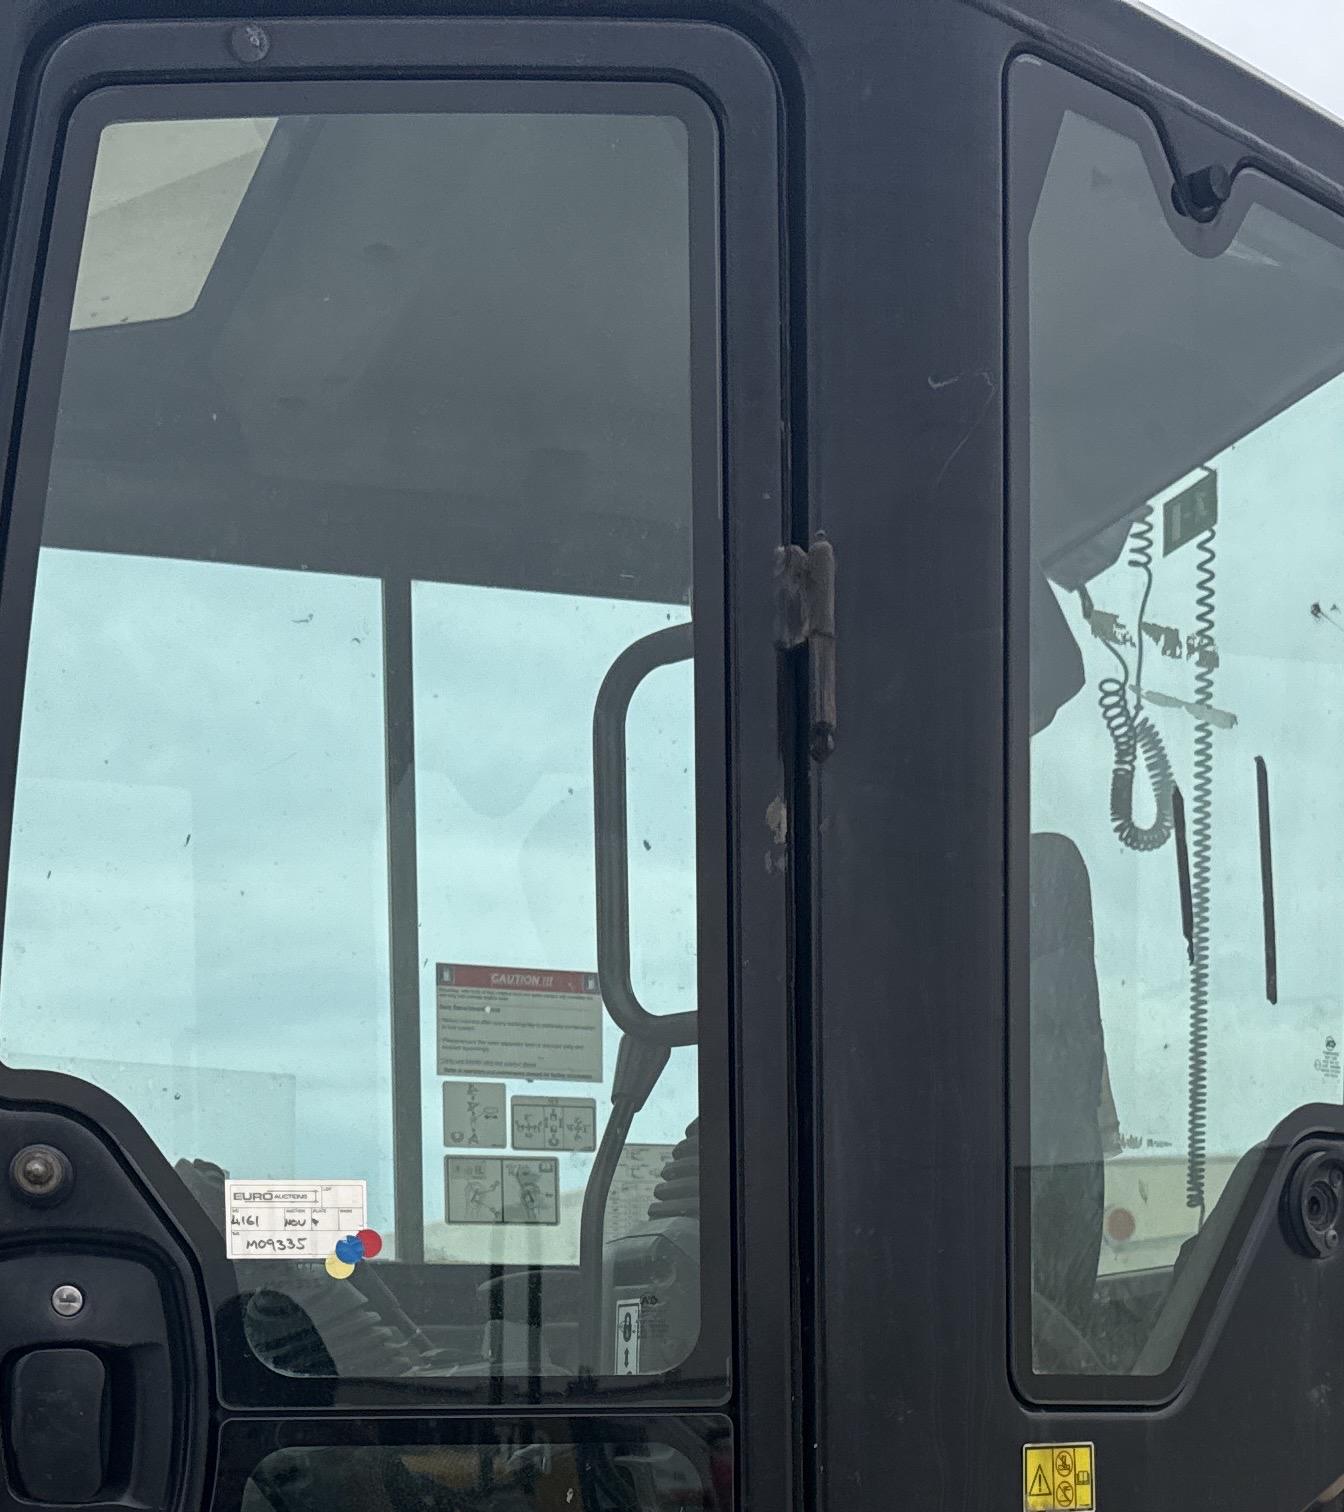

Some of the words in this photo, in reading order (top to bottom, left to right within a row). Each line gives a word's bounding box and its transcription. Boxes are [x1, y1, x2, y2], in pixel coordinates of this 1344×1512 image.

[491, 973, 540, 987] CAUTION
[233, 1192, 273, 1201] EURO
[231, 1215, 259, 1227] 4161
[246, 1238, 308, 1252] M09335
